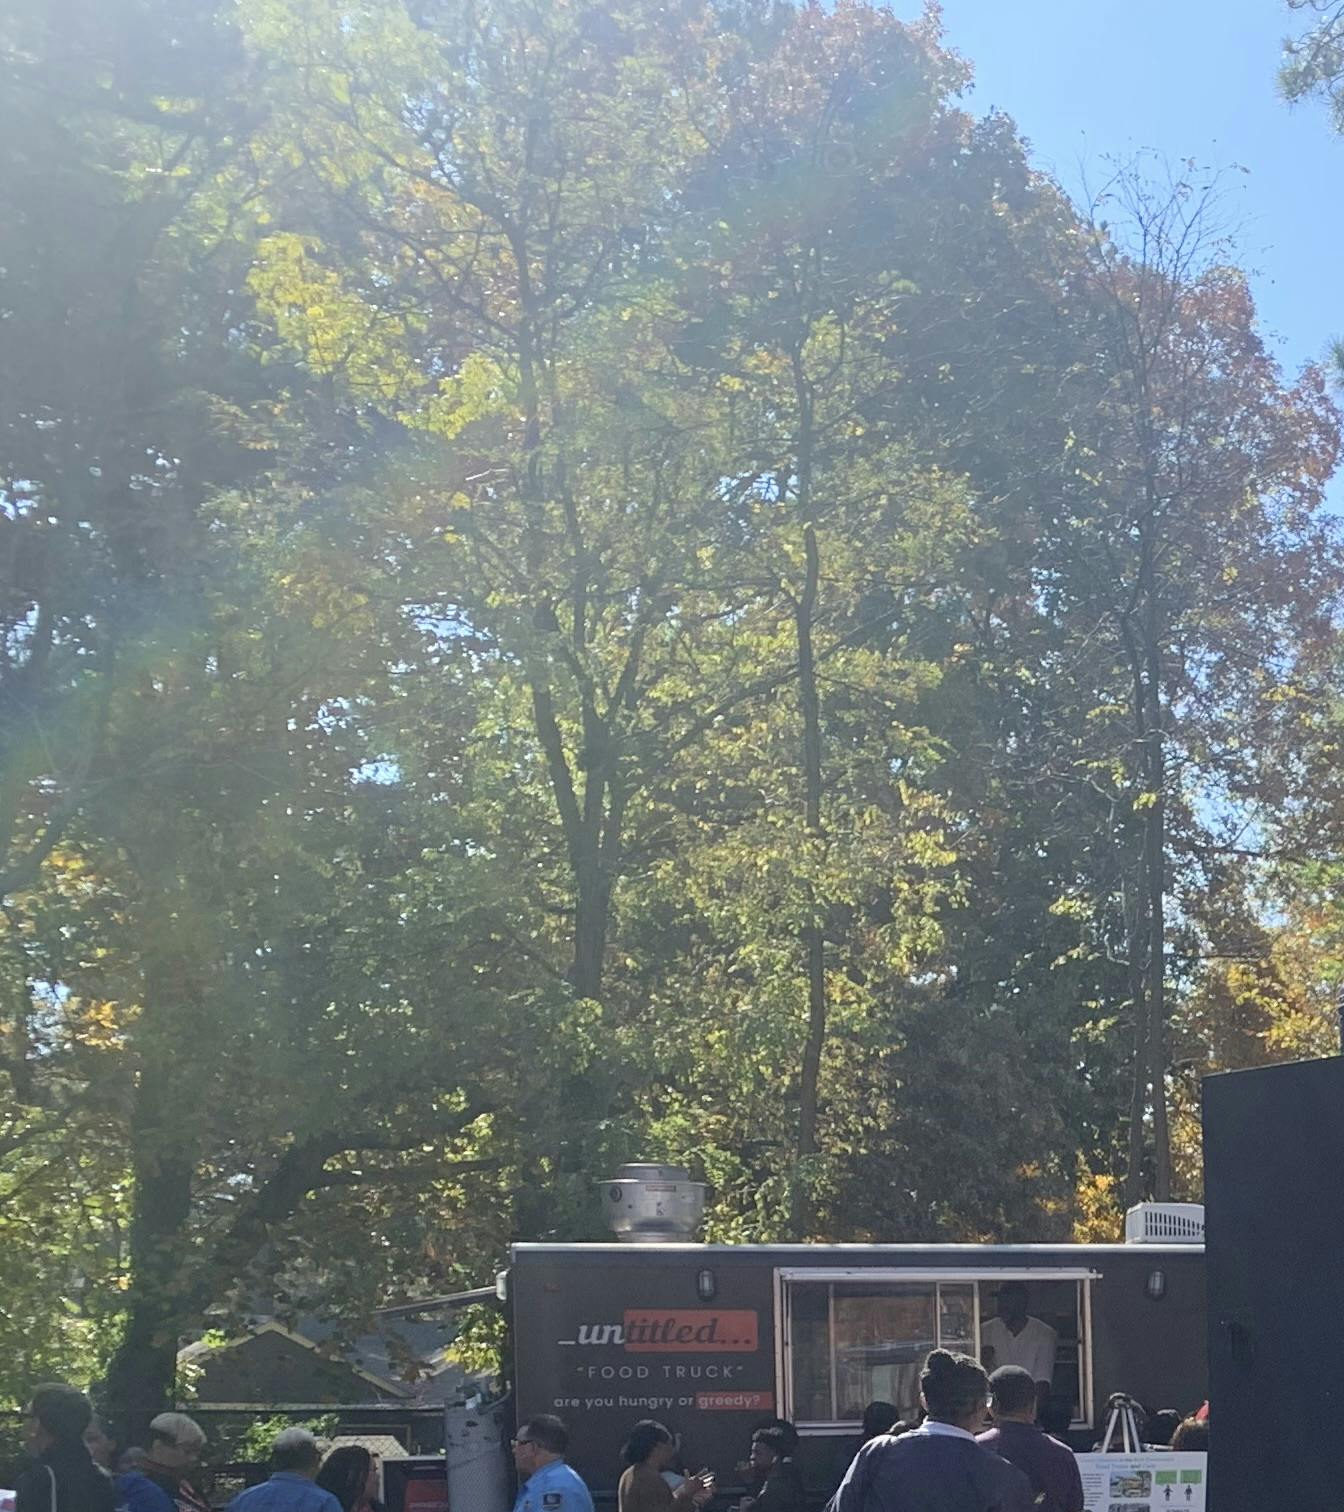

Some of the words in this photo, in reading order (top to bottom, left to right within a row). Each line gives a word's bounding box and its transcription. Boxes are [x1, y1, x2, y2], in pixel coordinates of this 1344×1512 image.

[553, 1397, 580, 1408] are
[585, 1398, 614, 1409] you
[618, 1395, 674, 1409] hungry
[678, 1397, 693, 1407] or
[698, 1394, 761, 1409] greedy?
